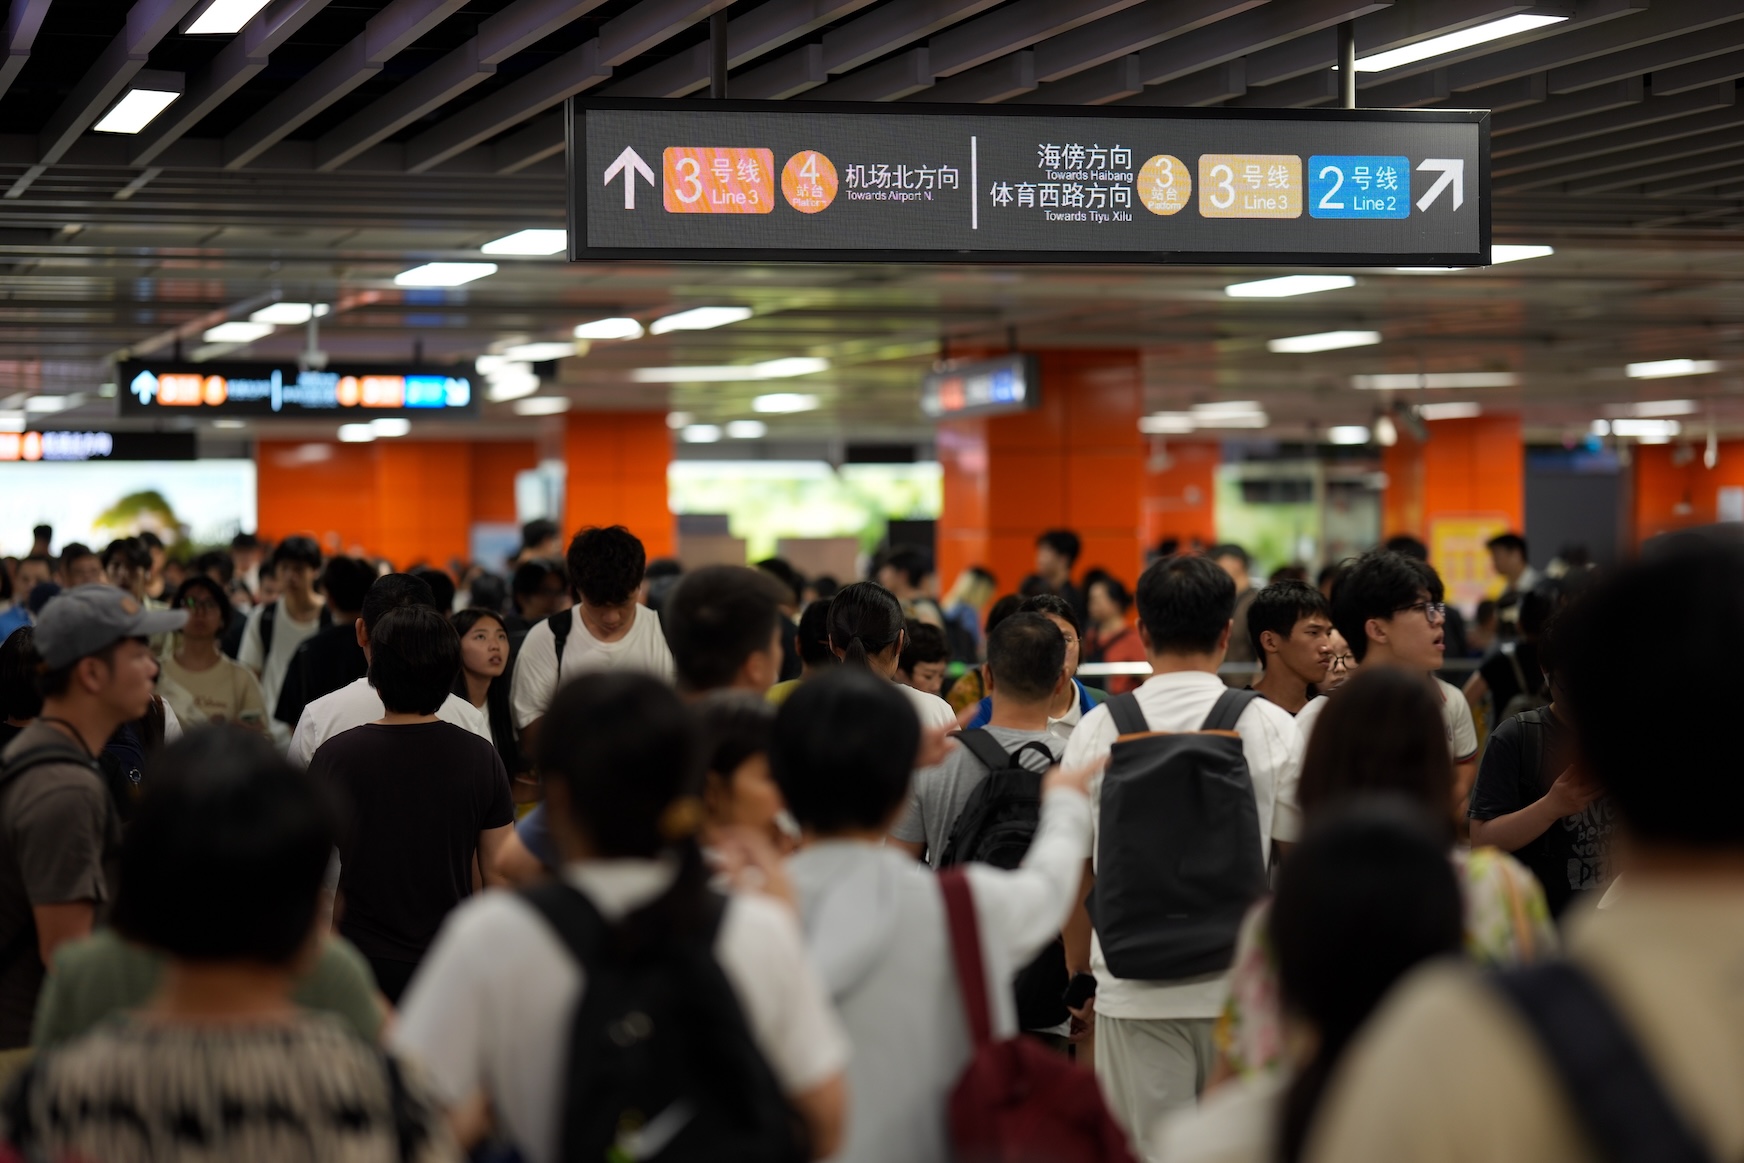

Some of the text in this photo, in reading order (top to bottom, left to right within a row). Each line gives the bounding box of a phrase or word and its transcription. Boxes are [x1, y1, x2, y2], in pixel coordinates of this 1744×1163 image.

[1038, 143, 1132, 170] 海傍方向
[800, 154, 820, 184] 4
[845, 164, 959, 190] 机场北方向
[1045, 170, 1134, 183] Towards Haibang
[1156, 158, 1174, 188] 3
[674, 158, 760, 203] 3 号线
[1210, 164, 1290, 209] 3 号线
[1318, 166, 1398, 209] 2 号线
[712, 190, 759, 205] Line 3
[796, 184, 824, 198] 站台
[846, 190, 934, 203] Towards Airport N.
[990, 181, 1131, 209] 体育西路方向
[1151, 188, 1178, 201] 站台
[1245, 196, 1288, 209] Line 3
[1354, 196, 1396, 210] Line 2
[1044, 210, 1132, 224] Towards Tiyu Xilu
